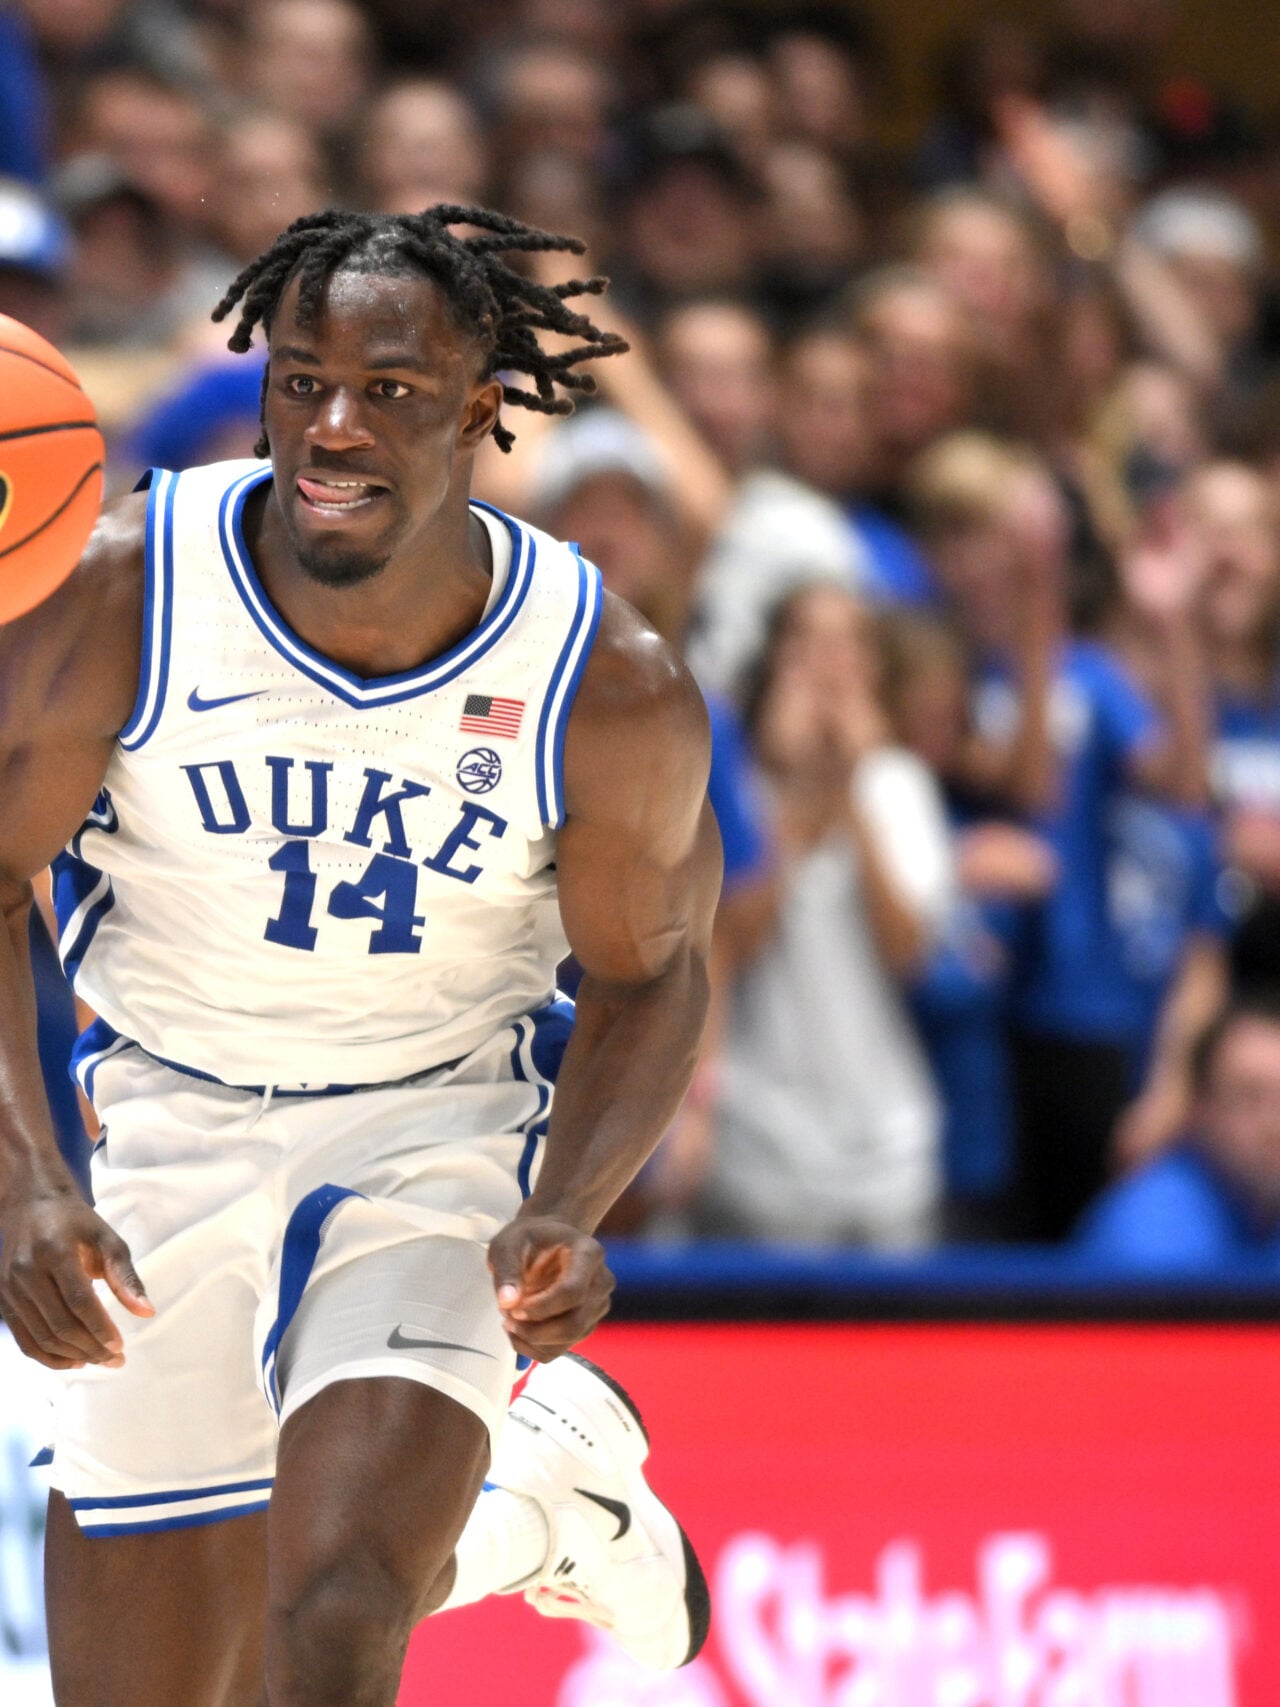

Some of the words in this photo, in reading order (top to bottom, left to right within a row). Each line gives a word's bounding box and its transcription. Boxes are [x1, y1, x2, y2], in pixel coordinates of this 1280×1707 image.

[179, 755, 509, 885] DUKE
[462, 762, 500, 779] ACC
[263, 840, 426, 955] 14
